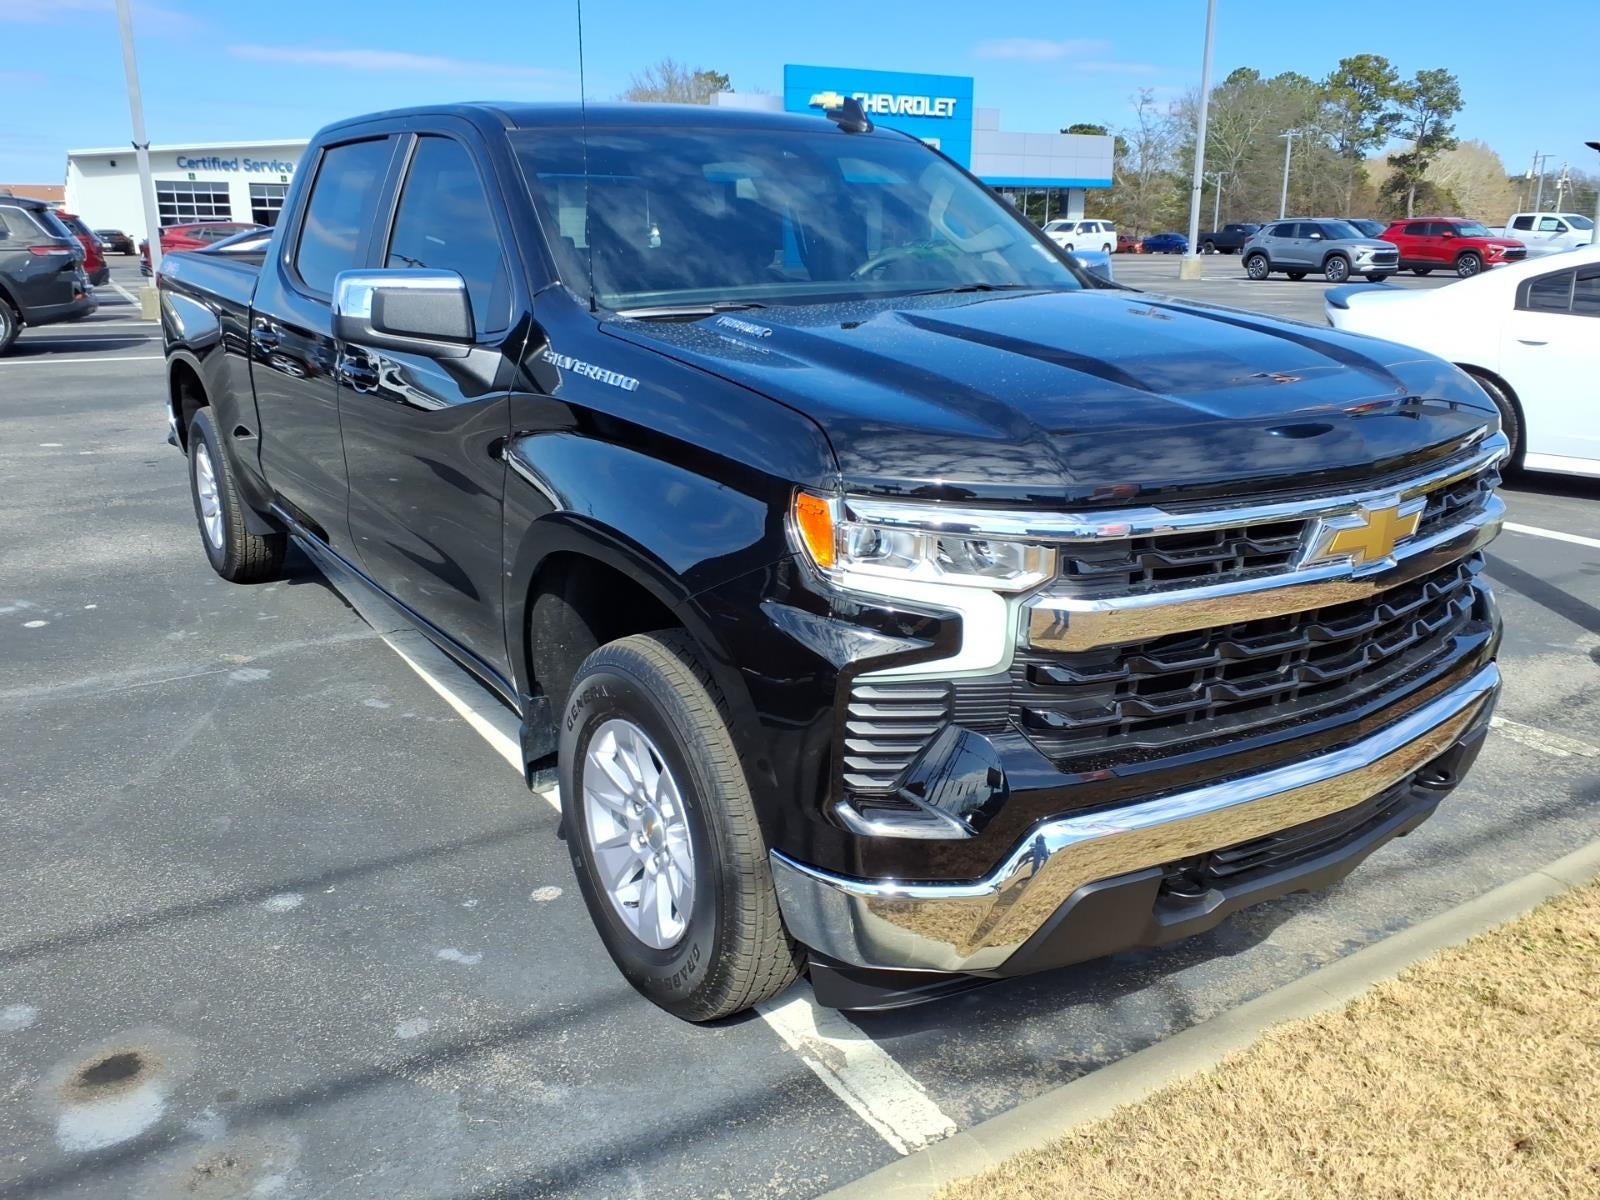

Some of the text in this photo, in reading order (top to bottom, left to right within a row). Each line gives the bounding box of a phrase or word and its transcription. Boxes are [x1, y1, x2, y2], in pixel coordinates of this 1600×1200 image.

[176, 155, 294, 174] Certified Service
[542, 350, 640, 392] SILVERADO
